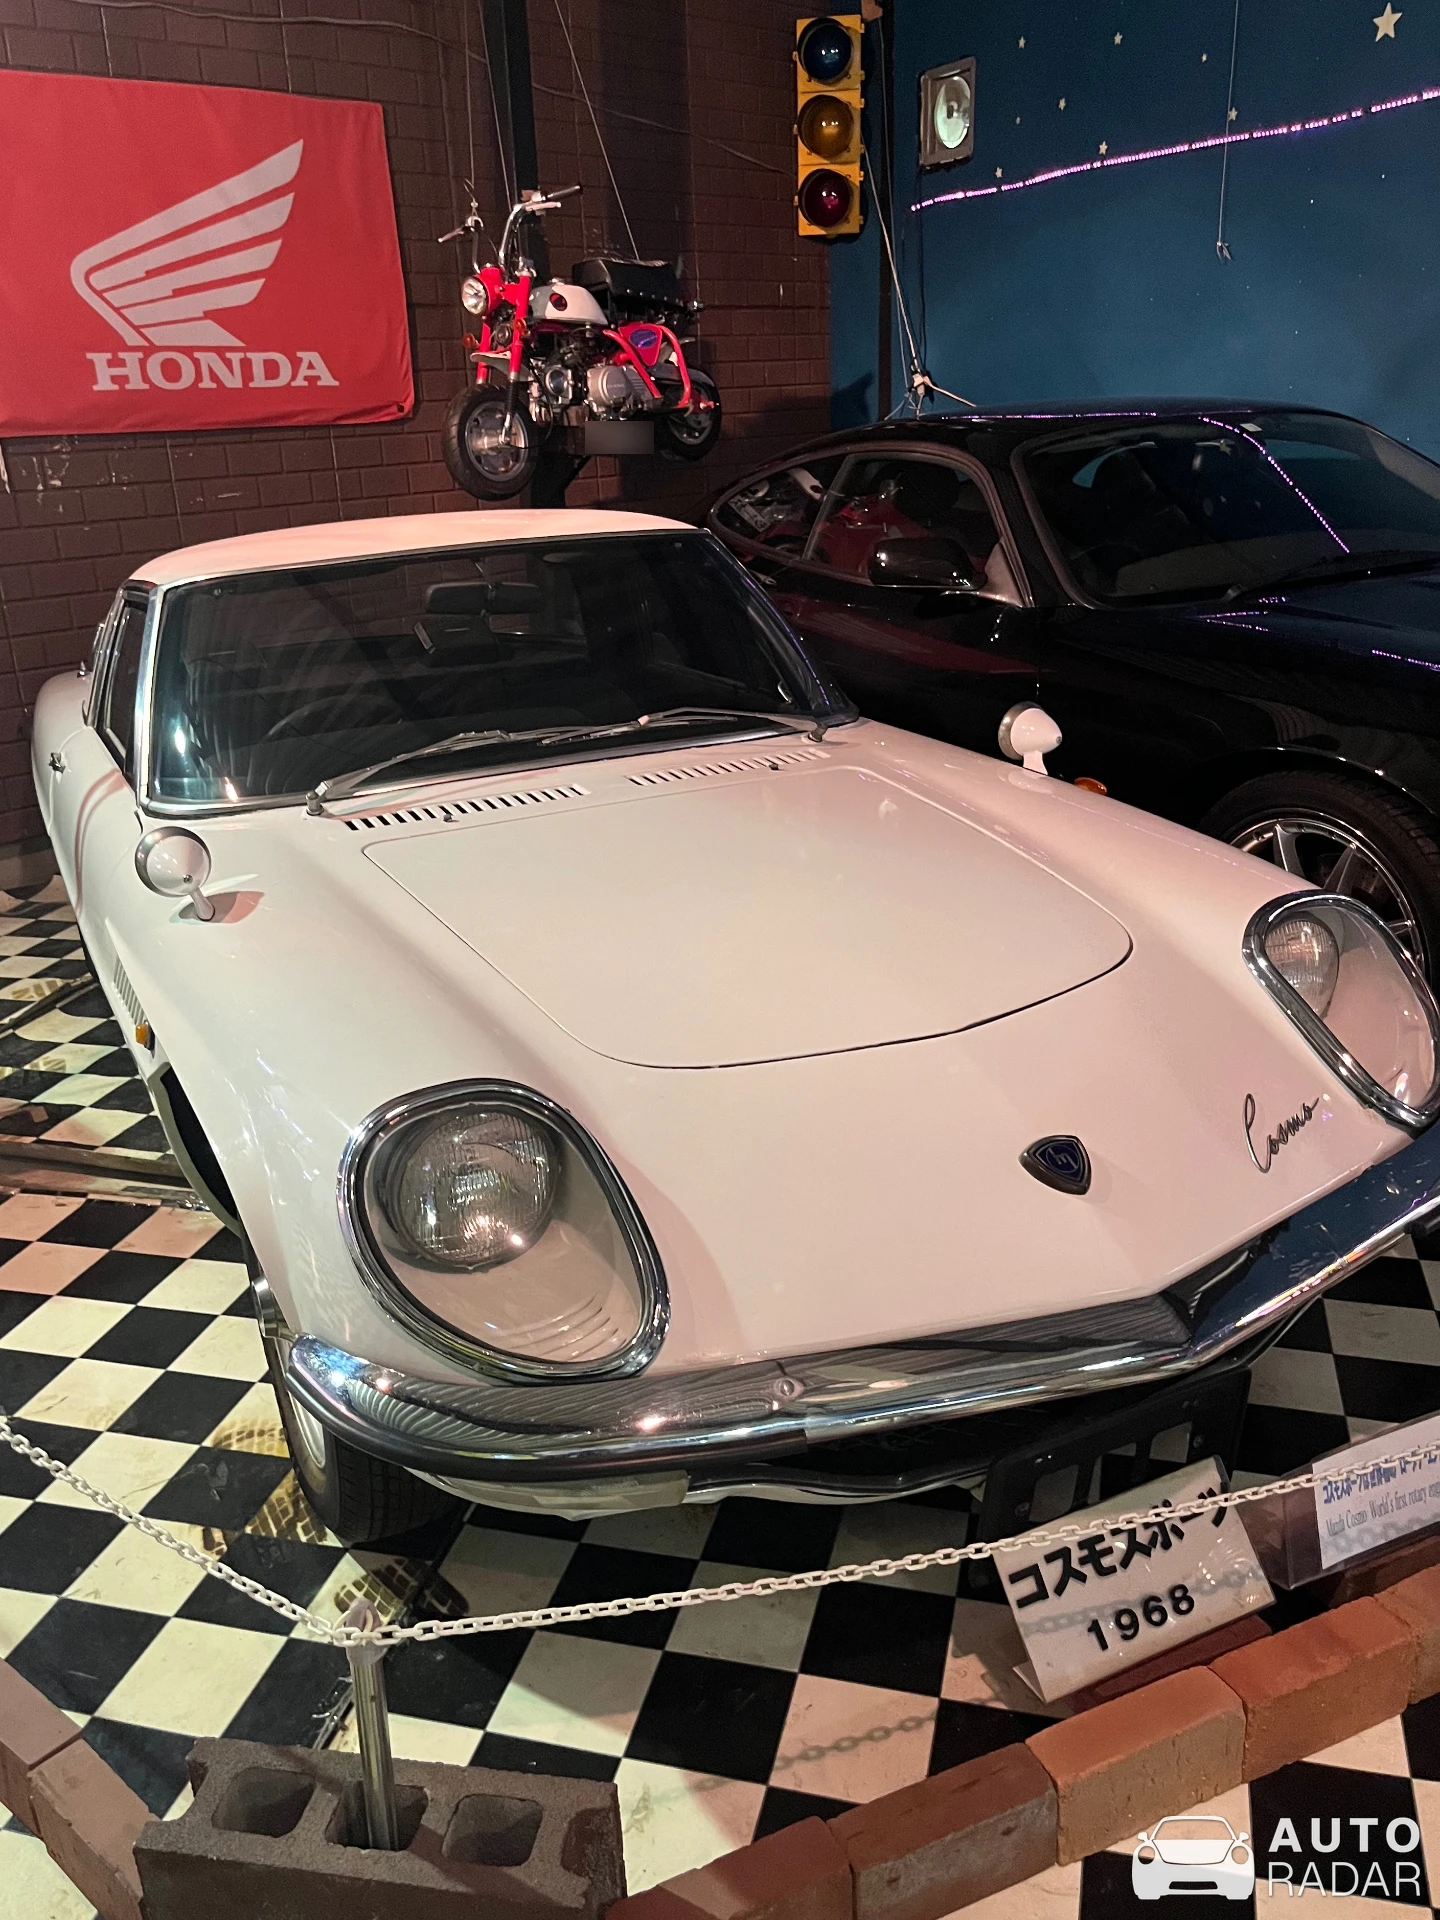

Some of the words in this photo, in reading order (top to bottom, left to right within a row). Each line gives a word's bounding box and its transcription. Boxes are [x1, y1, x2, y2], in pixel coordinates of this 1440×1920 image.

[86, 351, 339, 391] HONDA
[1243, 1093, 1320, 1173] Cosmo
[1087, 1584, 1195, 1651] 1968
